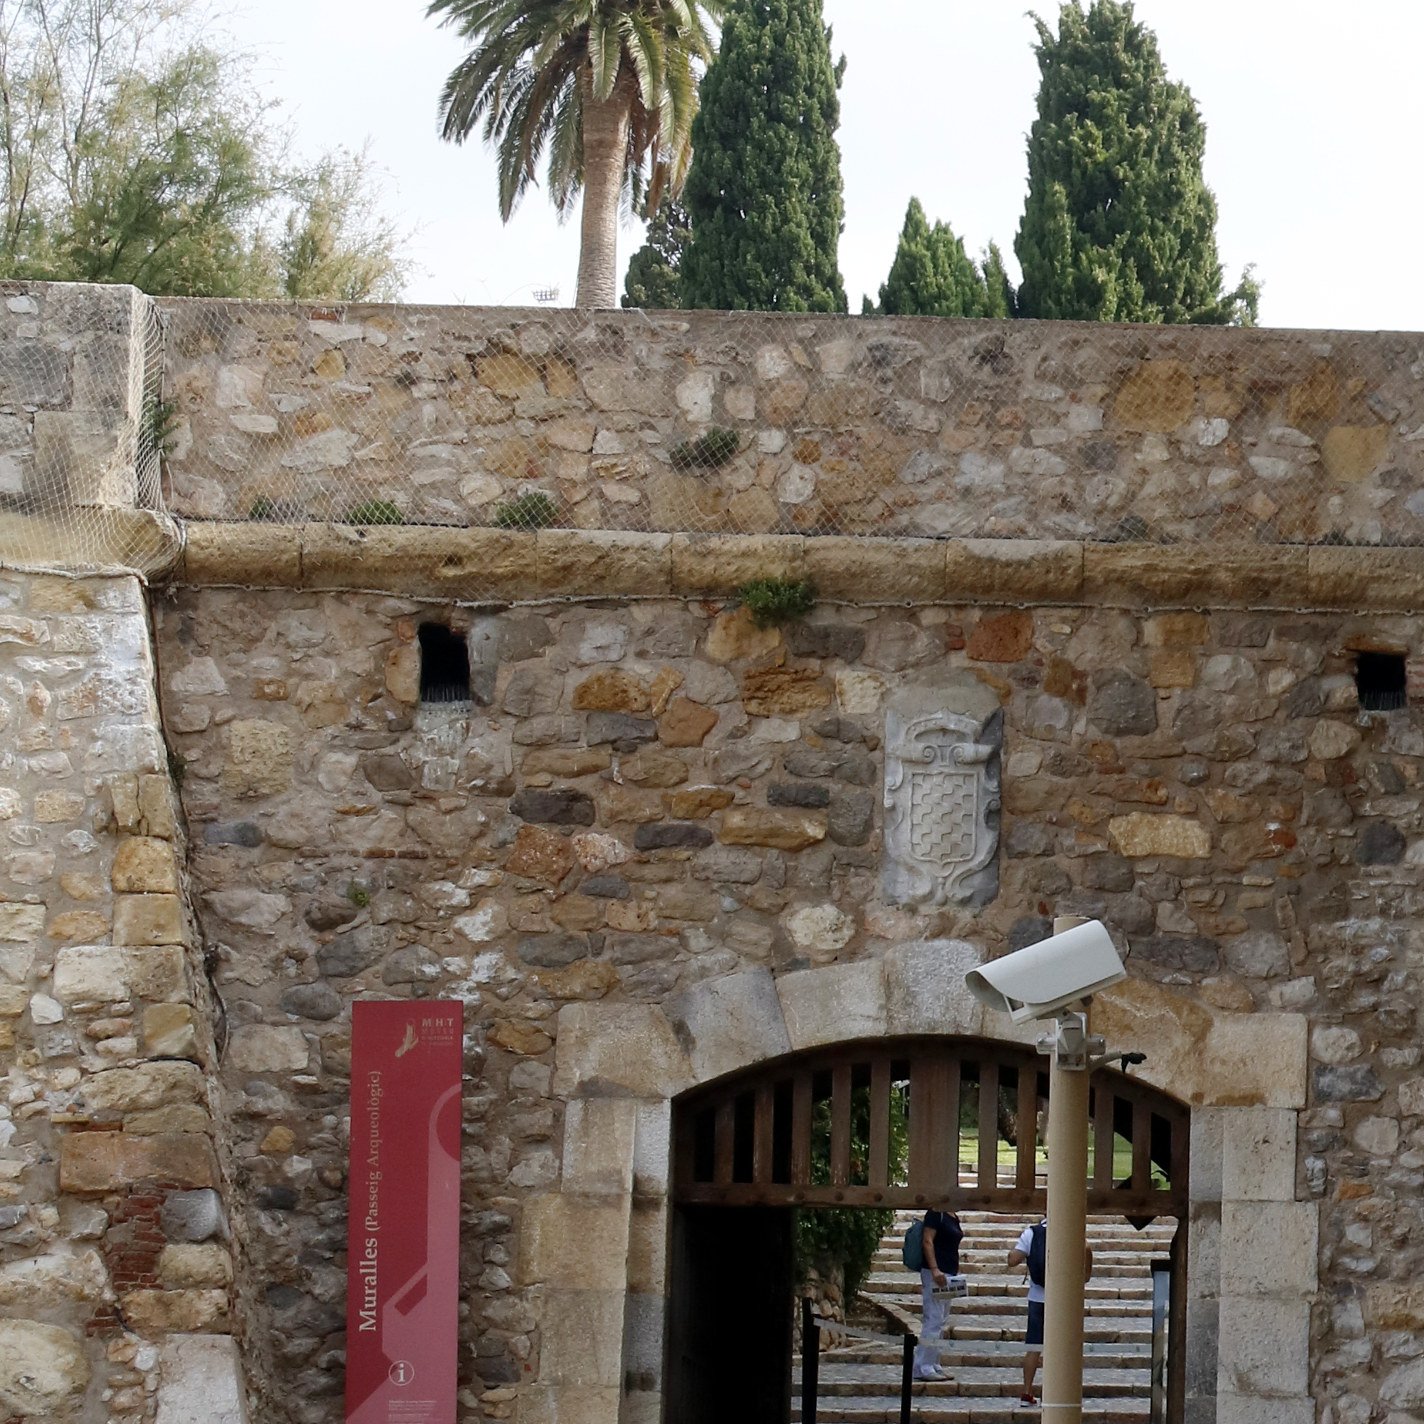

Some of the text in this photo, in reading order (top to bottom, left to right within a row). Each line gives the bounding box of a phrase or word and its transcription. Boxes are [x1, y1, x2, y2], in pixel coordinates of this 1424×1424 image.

[359, 1070, 384, 1332] Muralles (Passeig Arqueològic)
